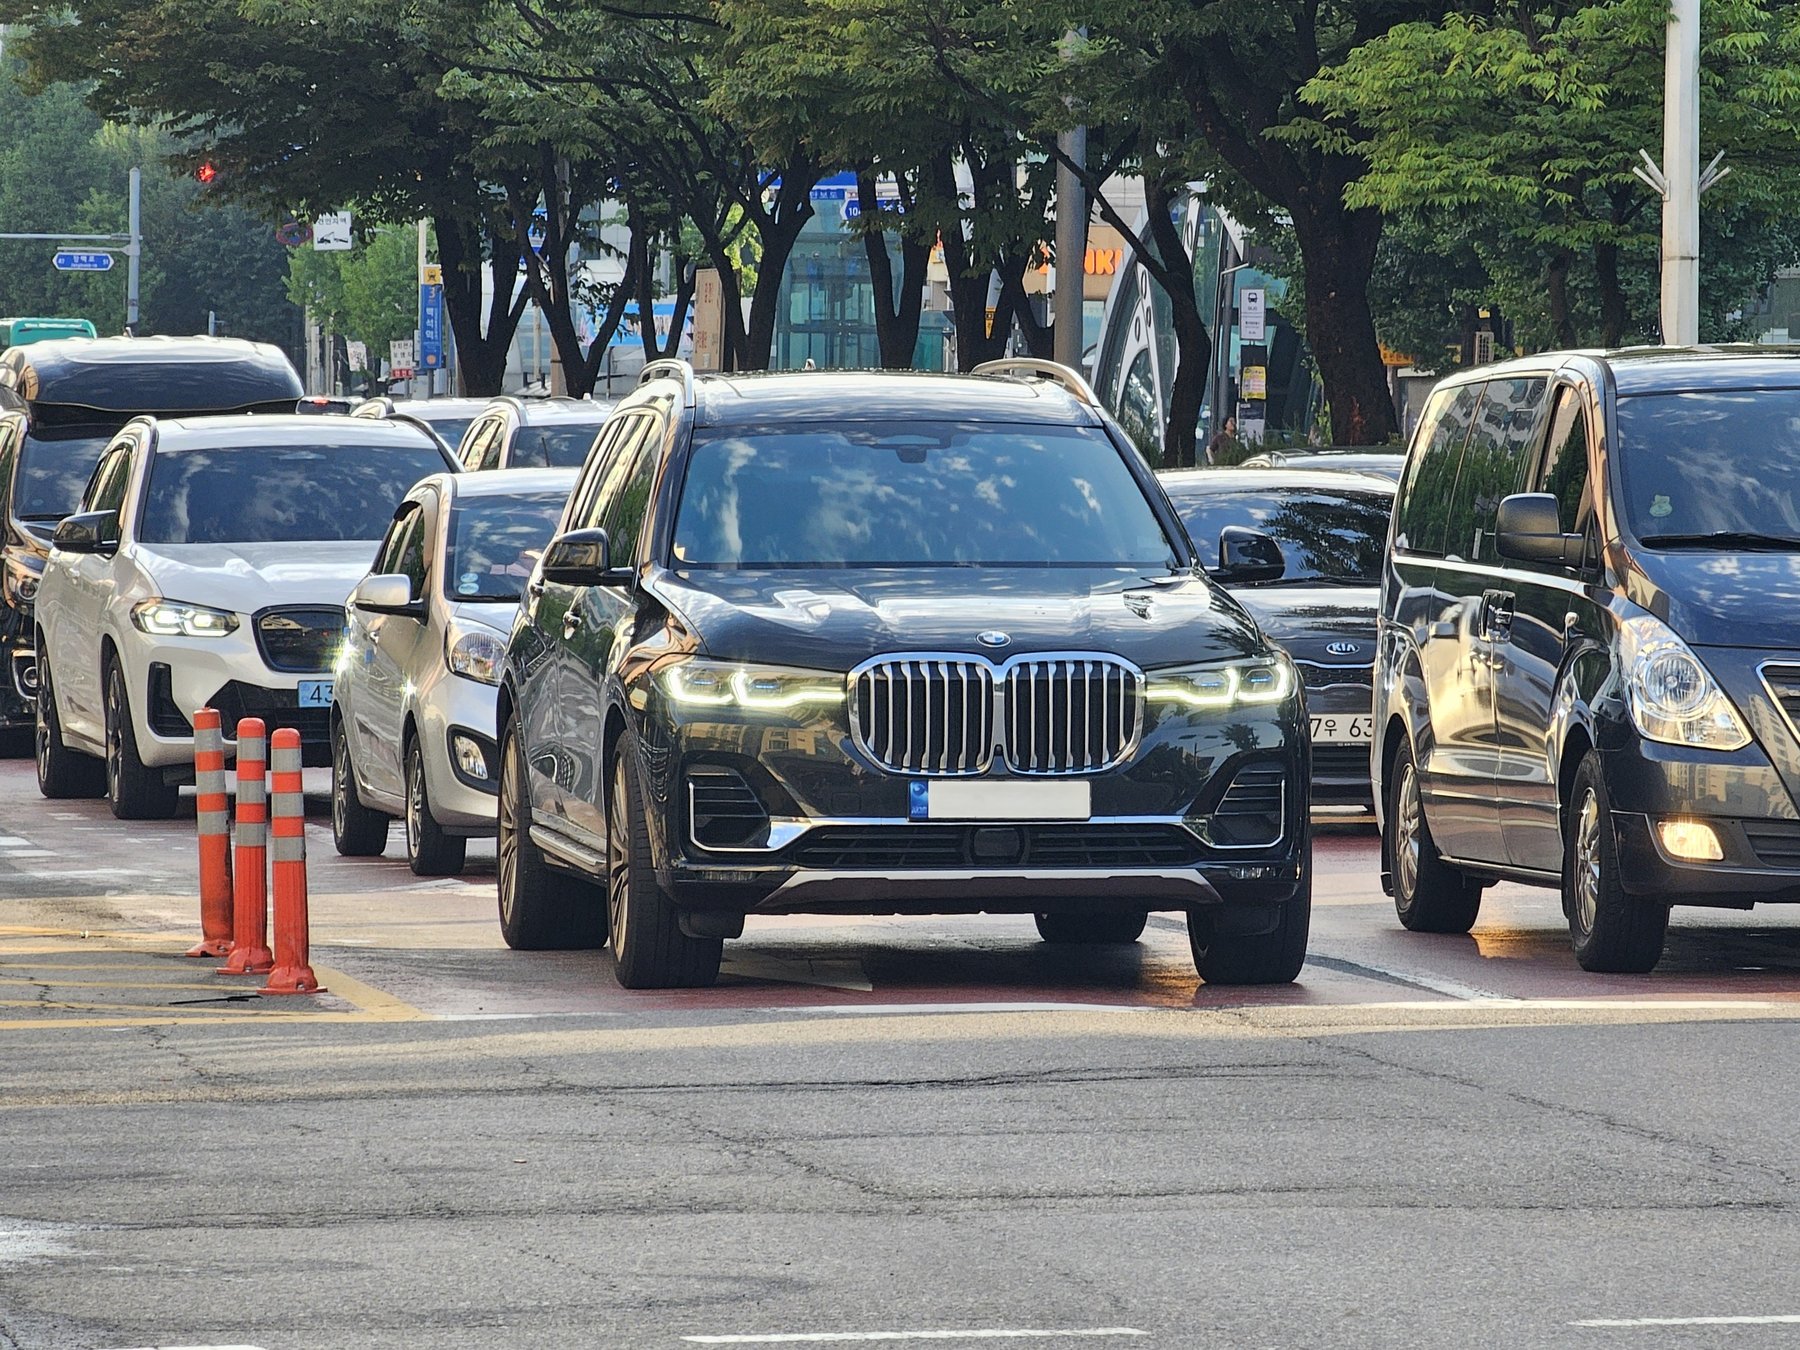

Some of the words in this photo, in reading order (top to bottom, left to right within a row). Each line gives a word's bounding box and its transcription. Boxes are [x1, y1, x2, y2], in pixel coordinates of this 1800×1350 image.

[848, 206, 861, 216] 10
[1332, 642, 1356, 652] KIA
[310, 684, 334, 704] 43
[1349, 717, 1373, 738] 63
